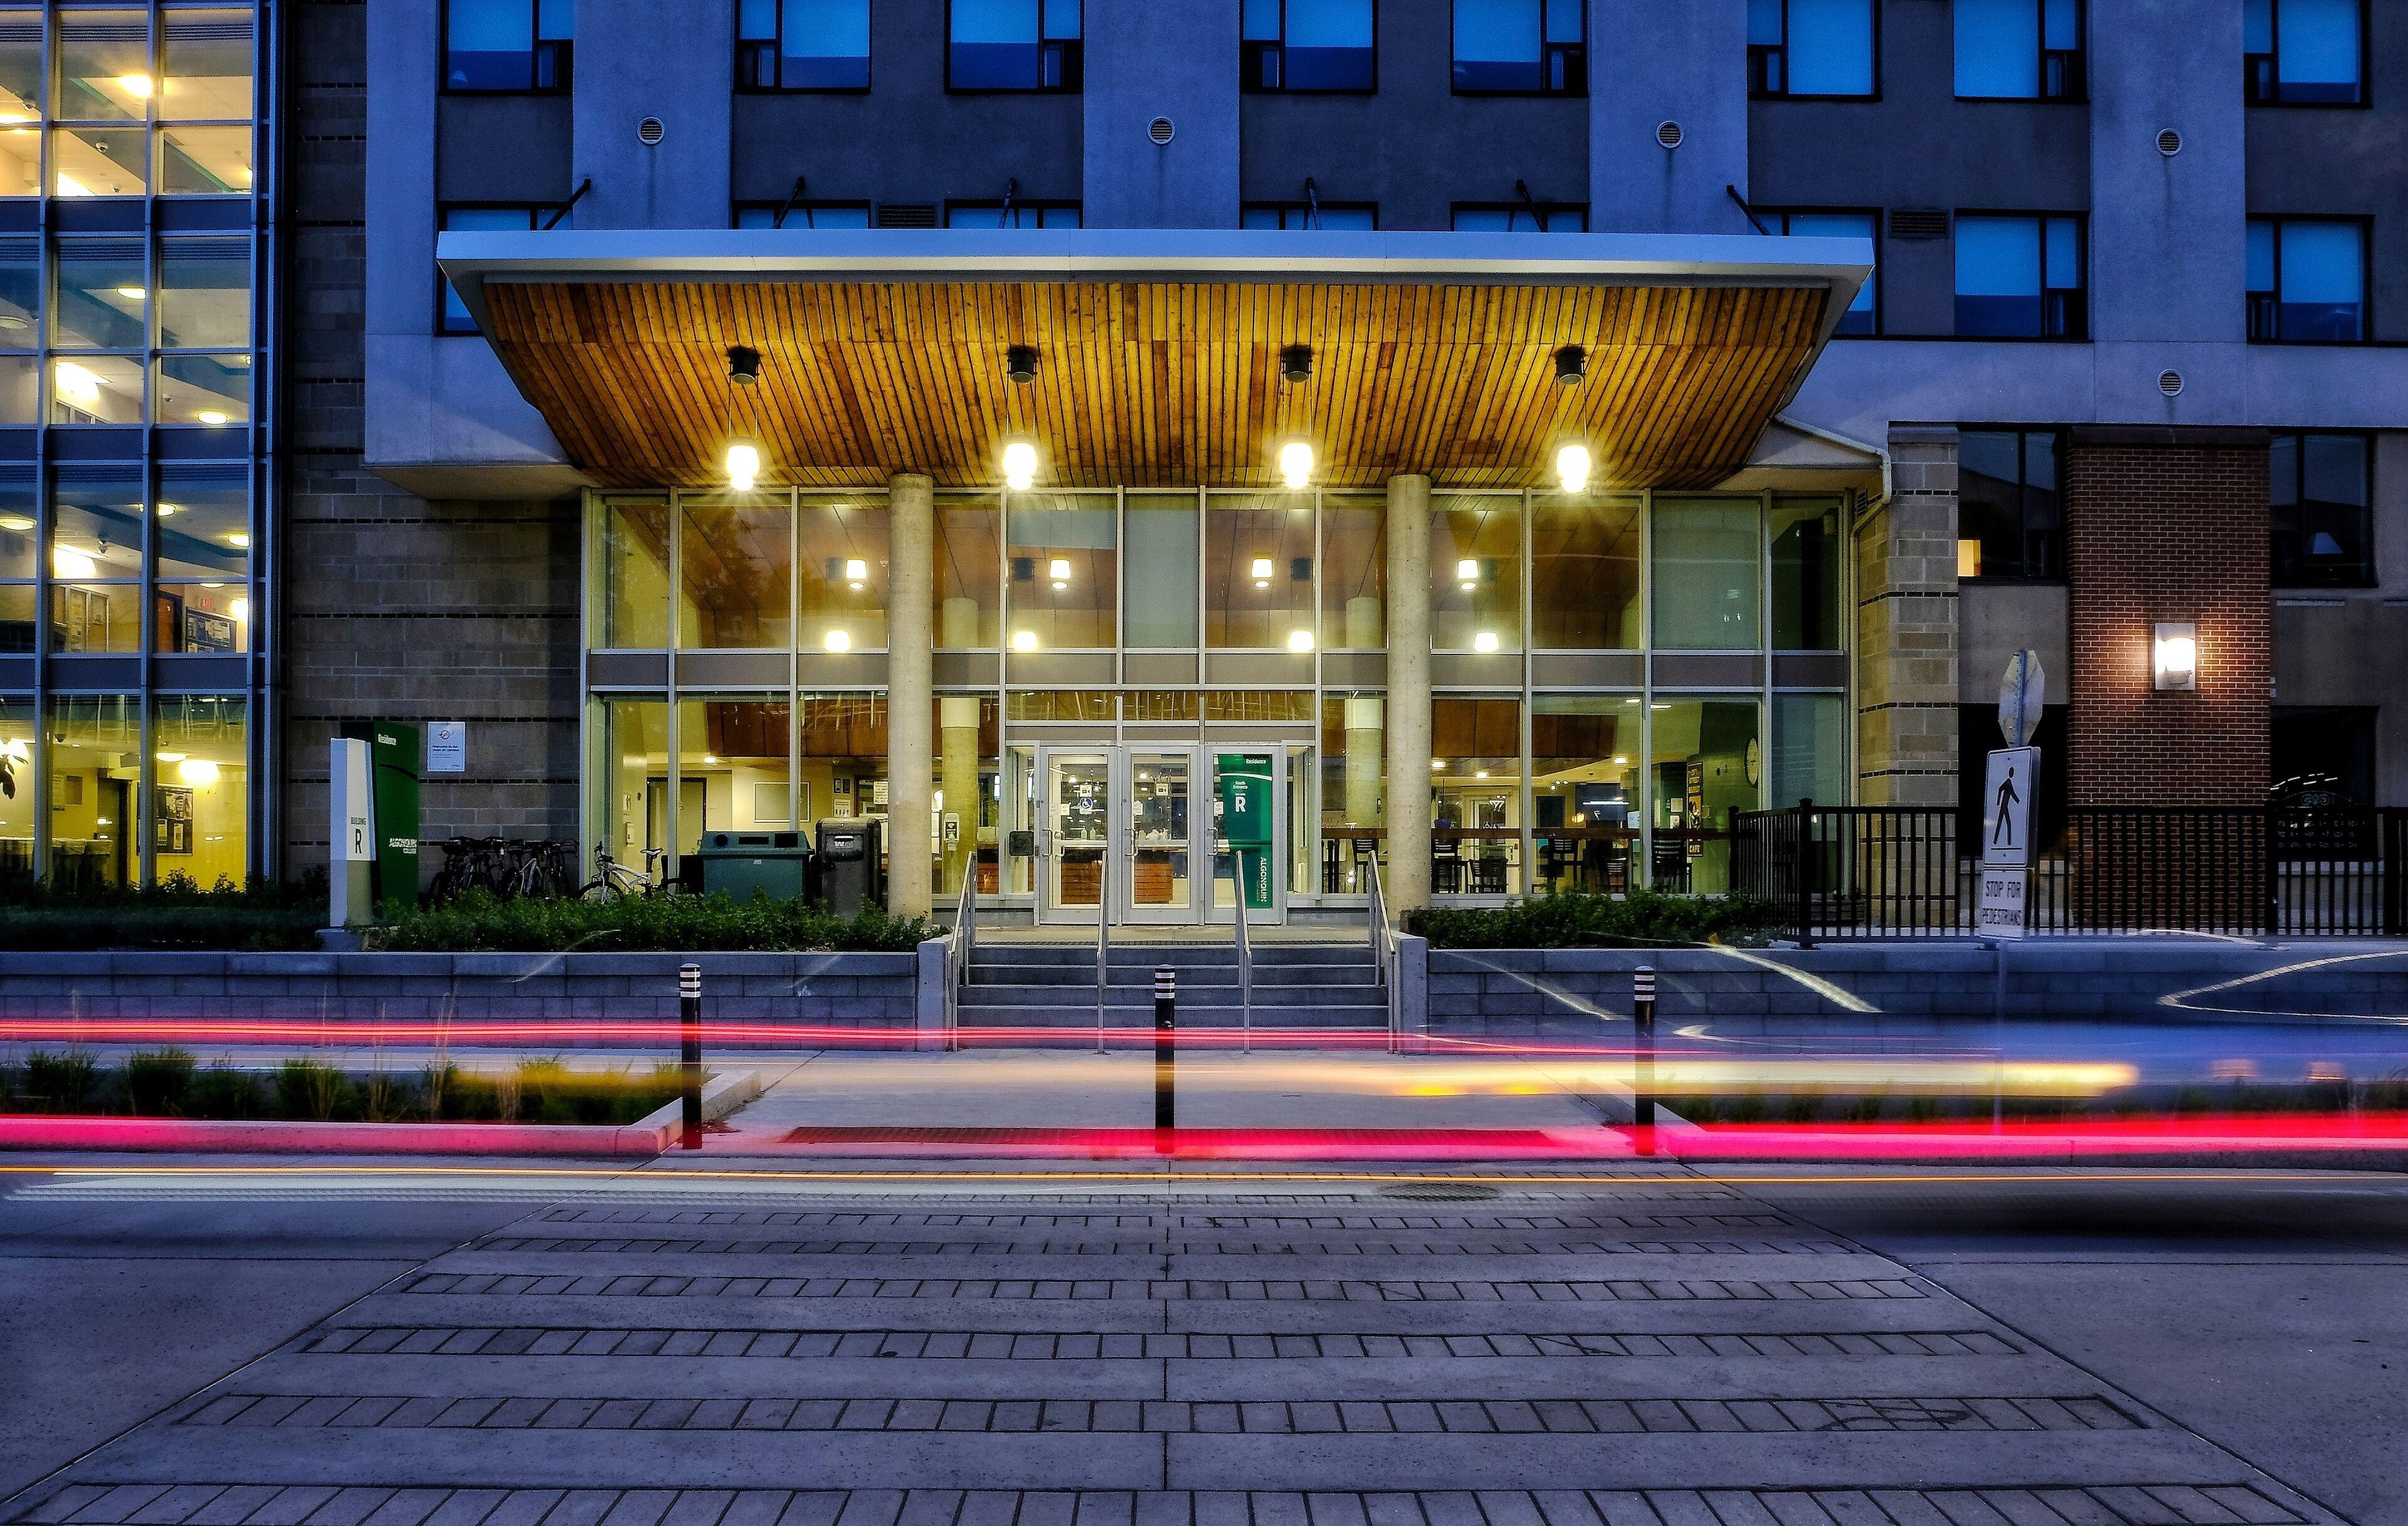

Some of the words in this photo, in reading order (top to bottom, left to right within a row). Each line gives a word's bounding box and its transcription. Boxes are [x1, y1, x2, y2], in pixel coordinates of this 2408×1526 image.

[1235, 796, 1246, 812] R
[355, 828, 362, 853] R
[1985, 880, 2004, 897] STOP
[2007, 881, 2021, 898] FOR
